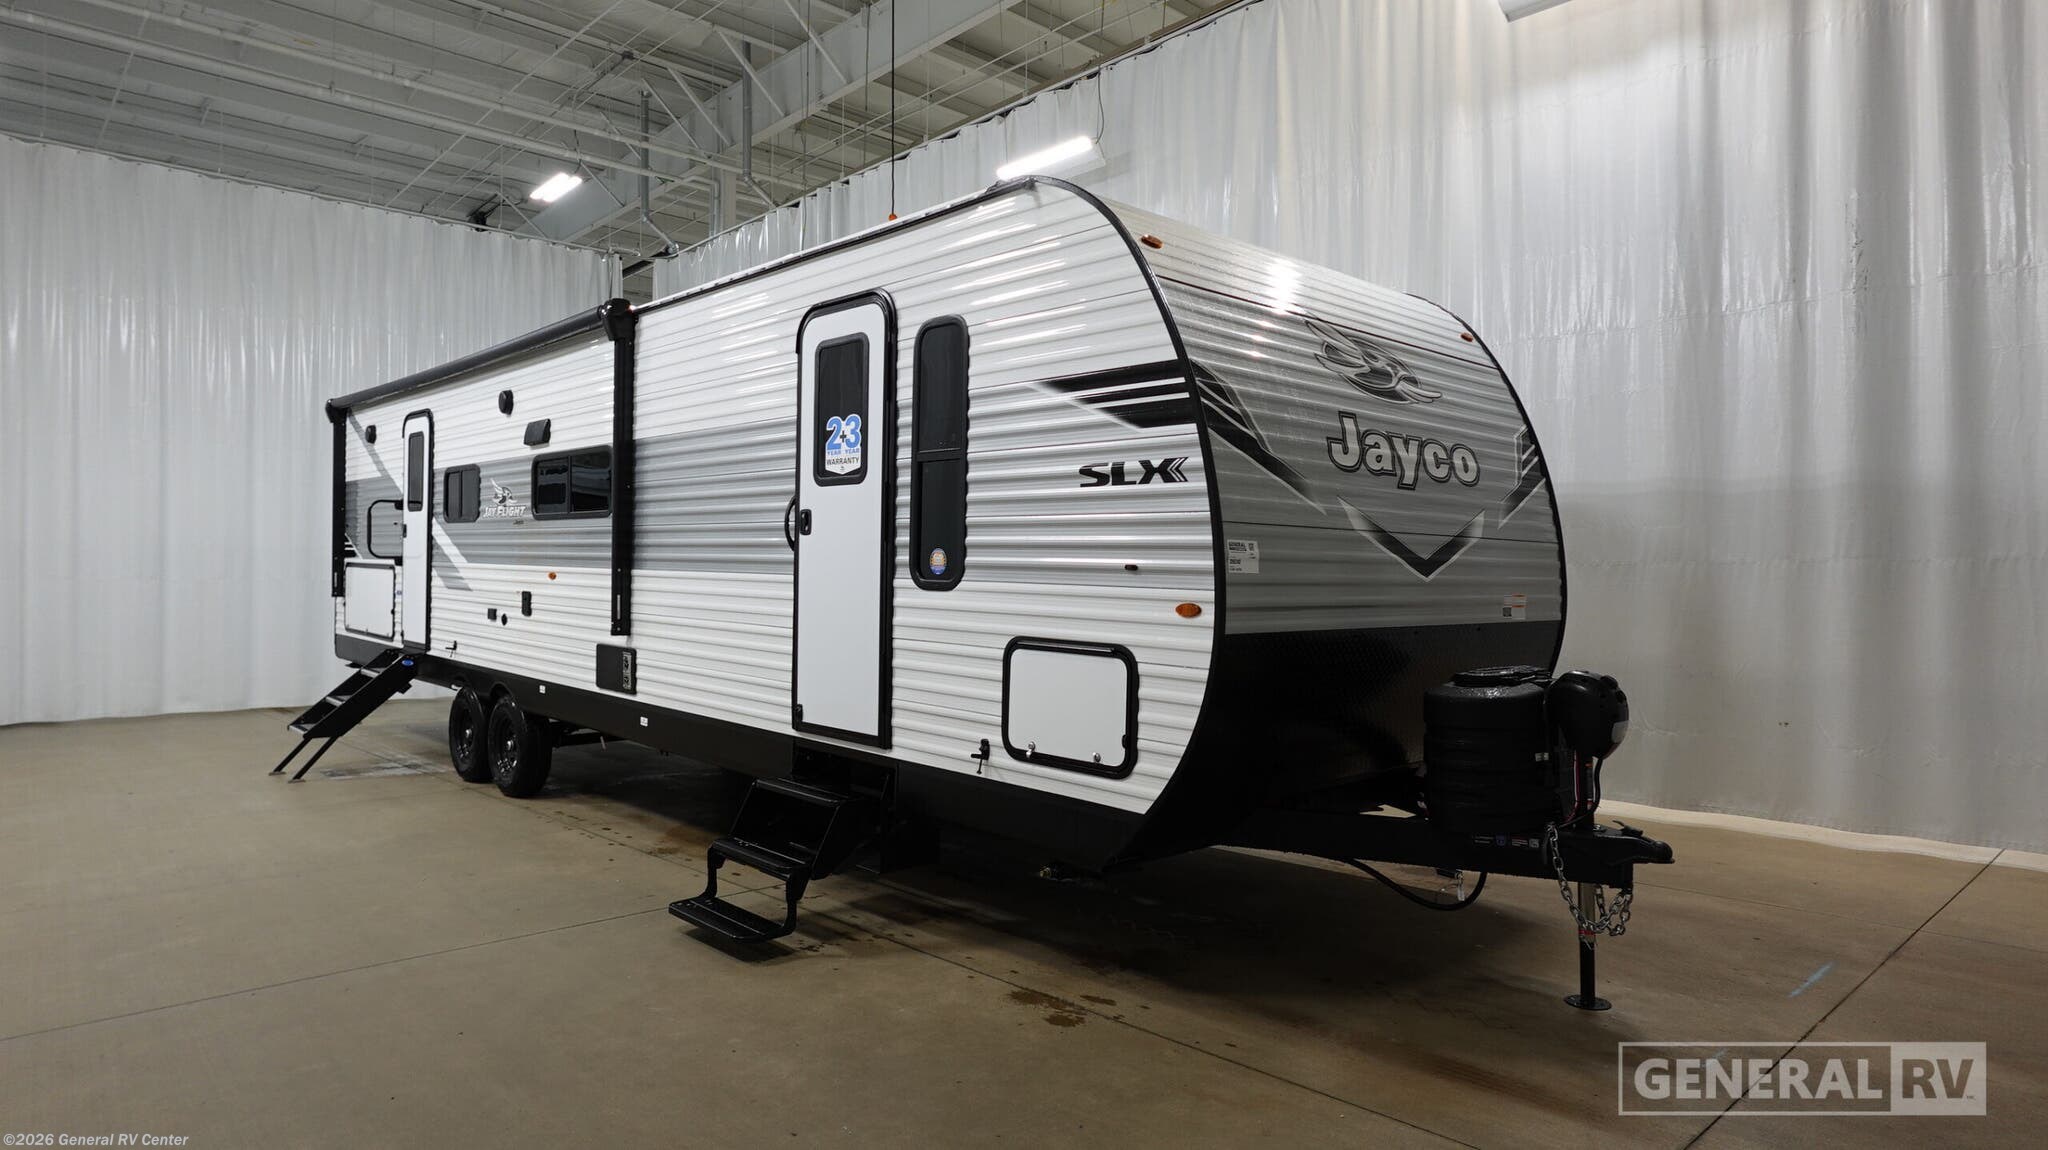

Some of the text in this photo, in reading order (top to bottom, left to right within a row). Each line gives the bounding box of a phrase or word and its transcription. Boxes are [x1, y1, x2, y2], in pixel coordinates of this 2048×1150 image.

[826, 457, 860, 466] WARRANTY
[1326, 411, 1480, 491] Jayco
[1079, 457, 1189, 487] SLX
[483, 506, 527, 518] JAY FLIGHT
